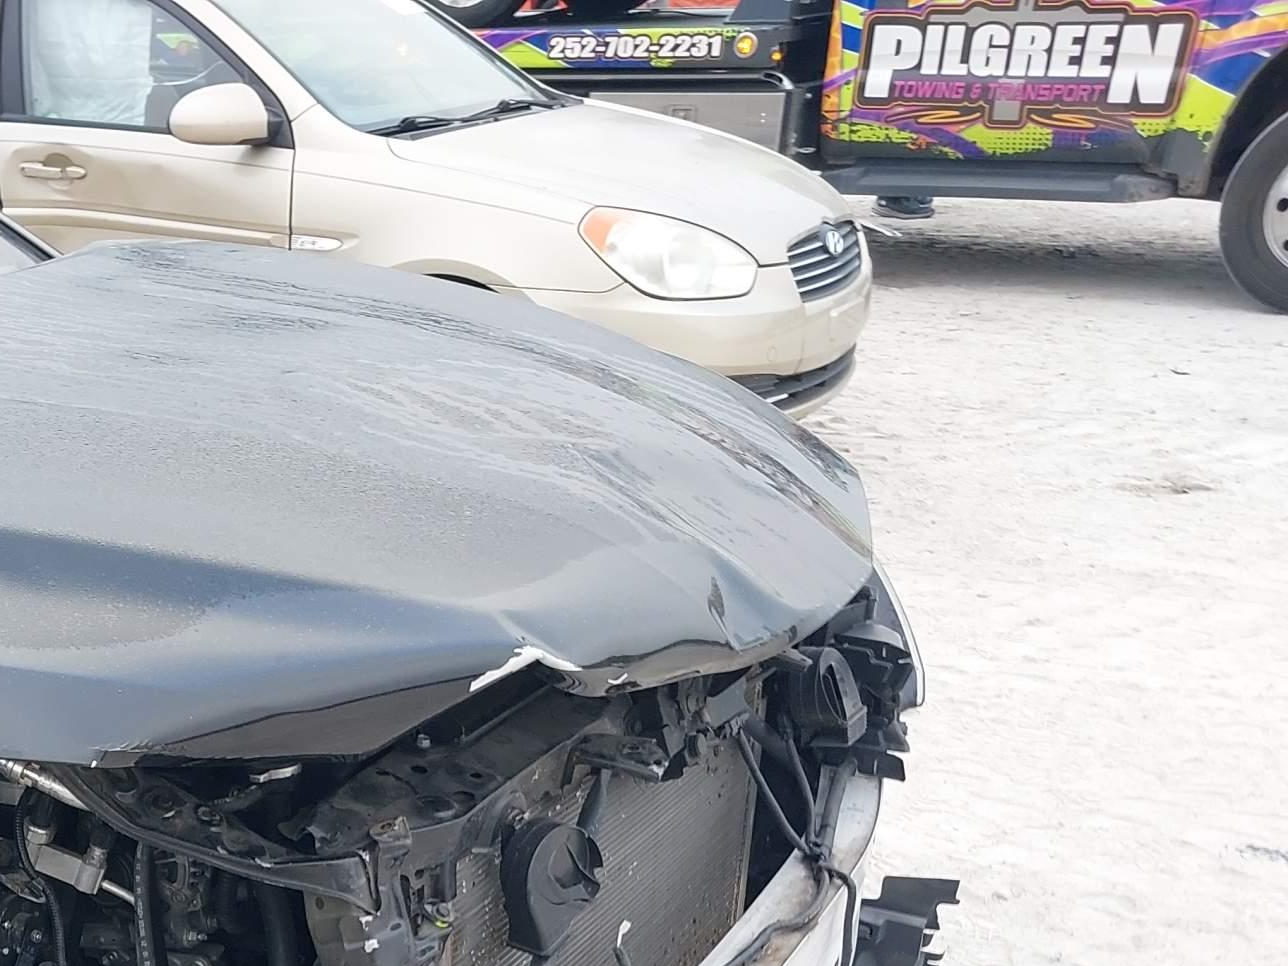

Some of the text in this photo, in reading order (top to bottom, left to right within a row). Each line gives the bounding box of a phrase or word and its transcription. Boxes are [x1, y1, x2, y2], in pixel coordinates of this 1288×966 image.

[548, 34, 723, 58] 252-702-2231
[864, 22, 1185, 104] PILGREEN
[893, 80, 1106, 102] TOWING & TRANSPORT
